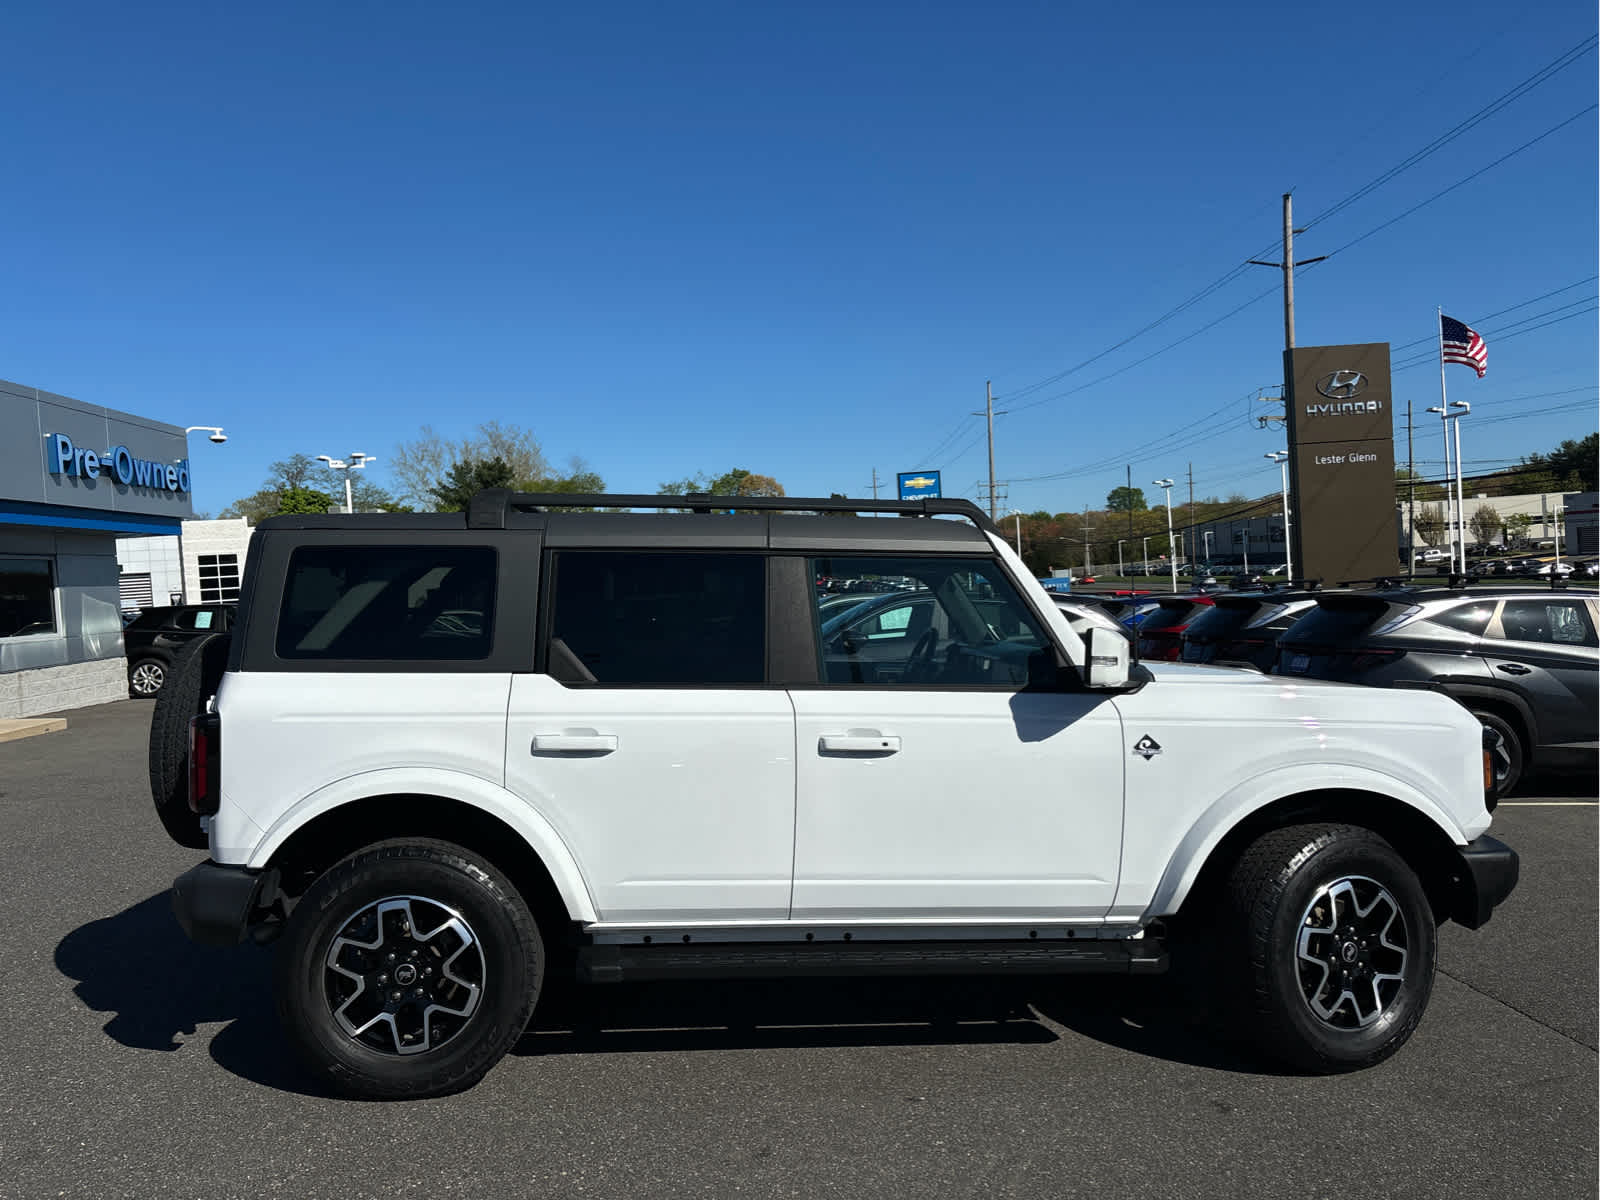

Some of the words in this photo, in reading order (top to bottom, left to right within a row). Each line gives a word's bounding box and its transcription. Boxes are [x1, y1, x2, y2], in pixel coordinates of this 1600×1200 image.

[1306, 401, 1382, 416] HYUNDAI
[48, 433, 191, 493] Pre-Owned
[1315, 454, 1345, 465] Lester
[1348, 452, 1377, 463] Glenn
